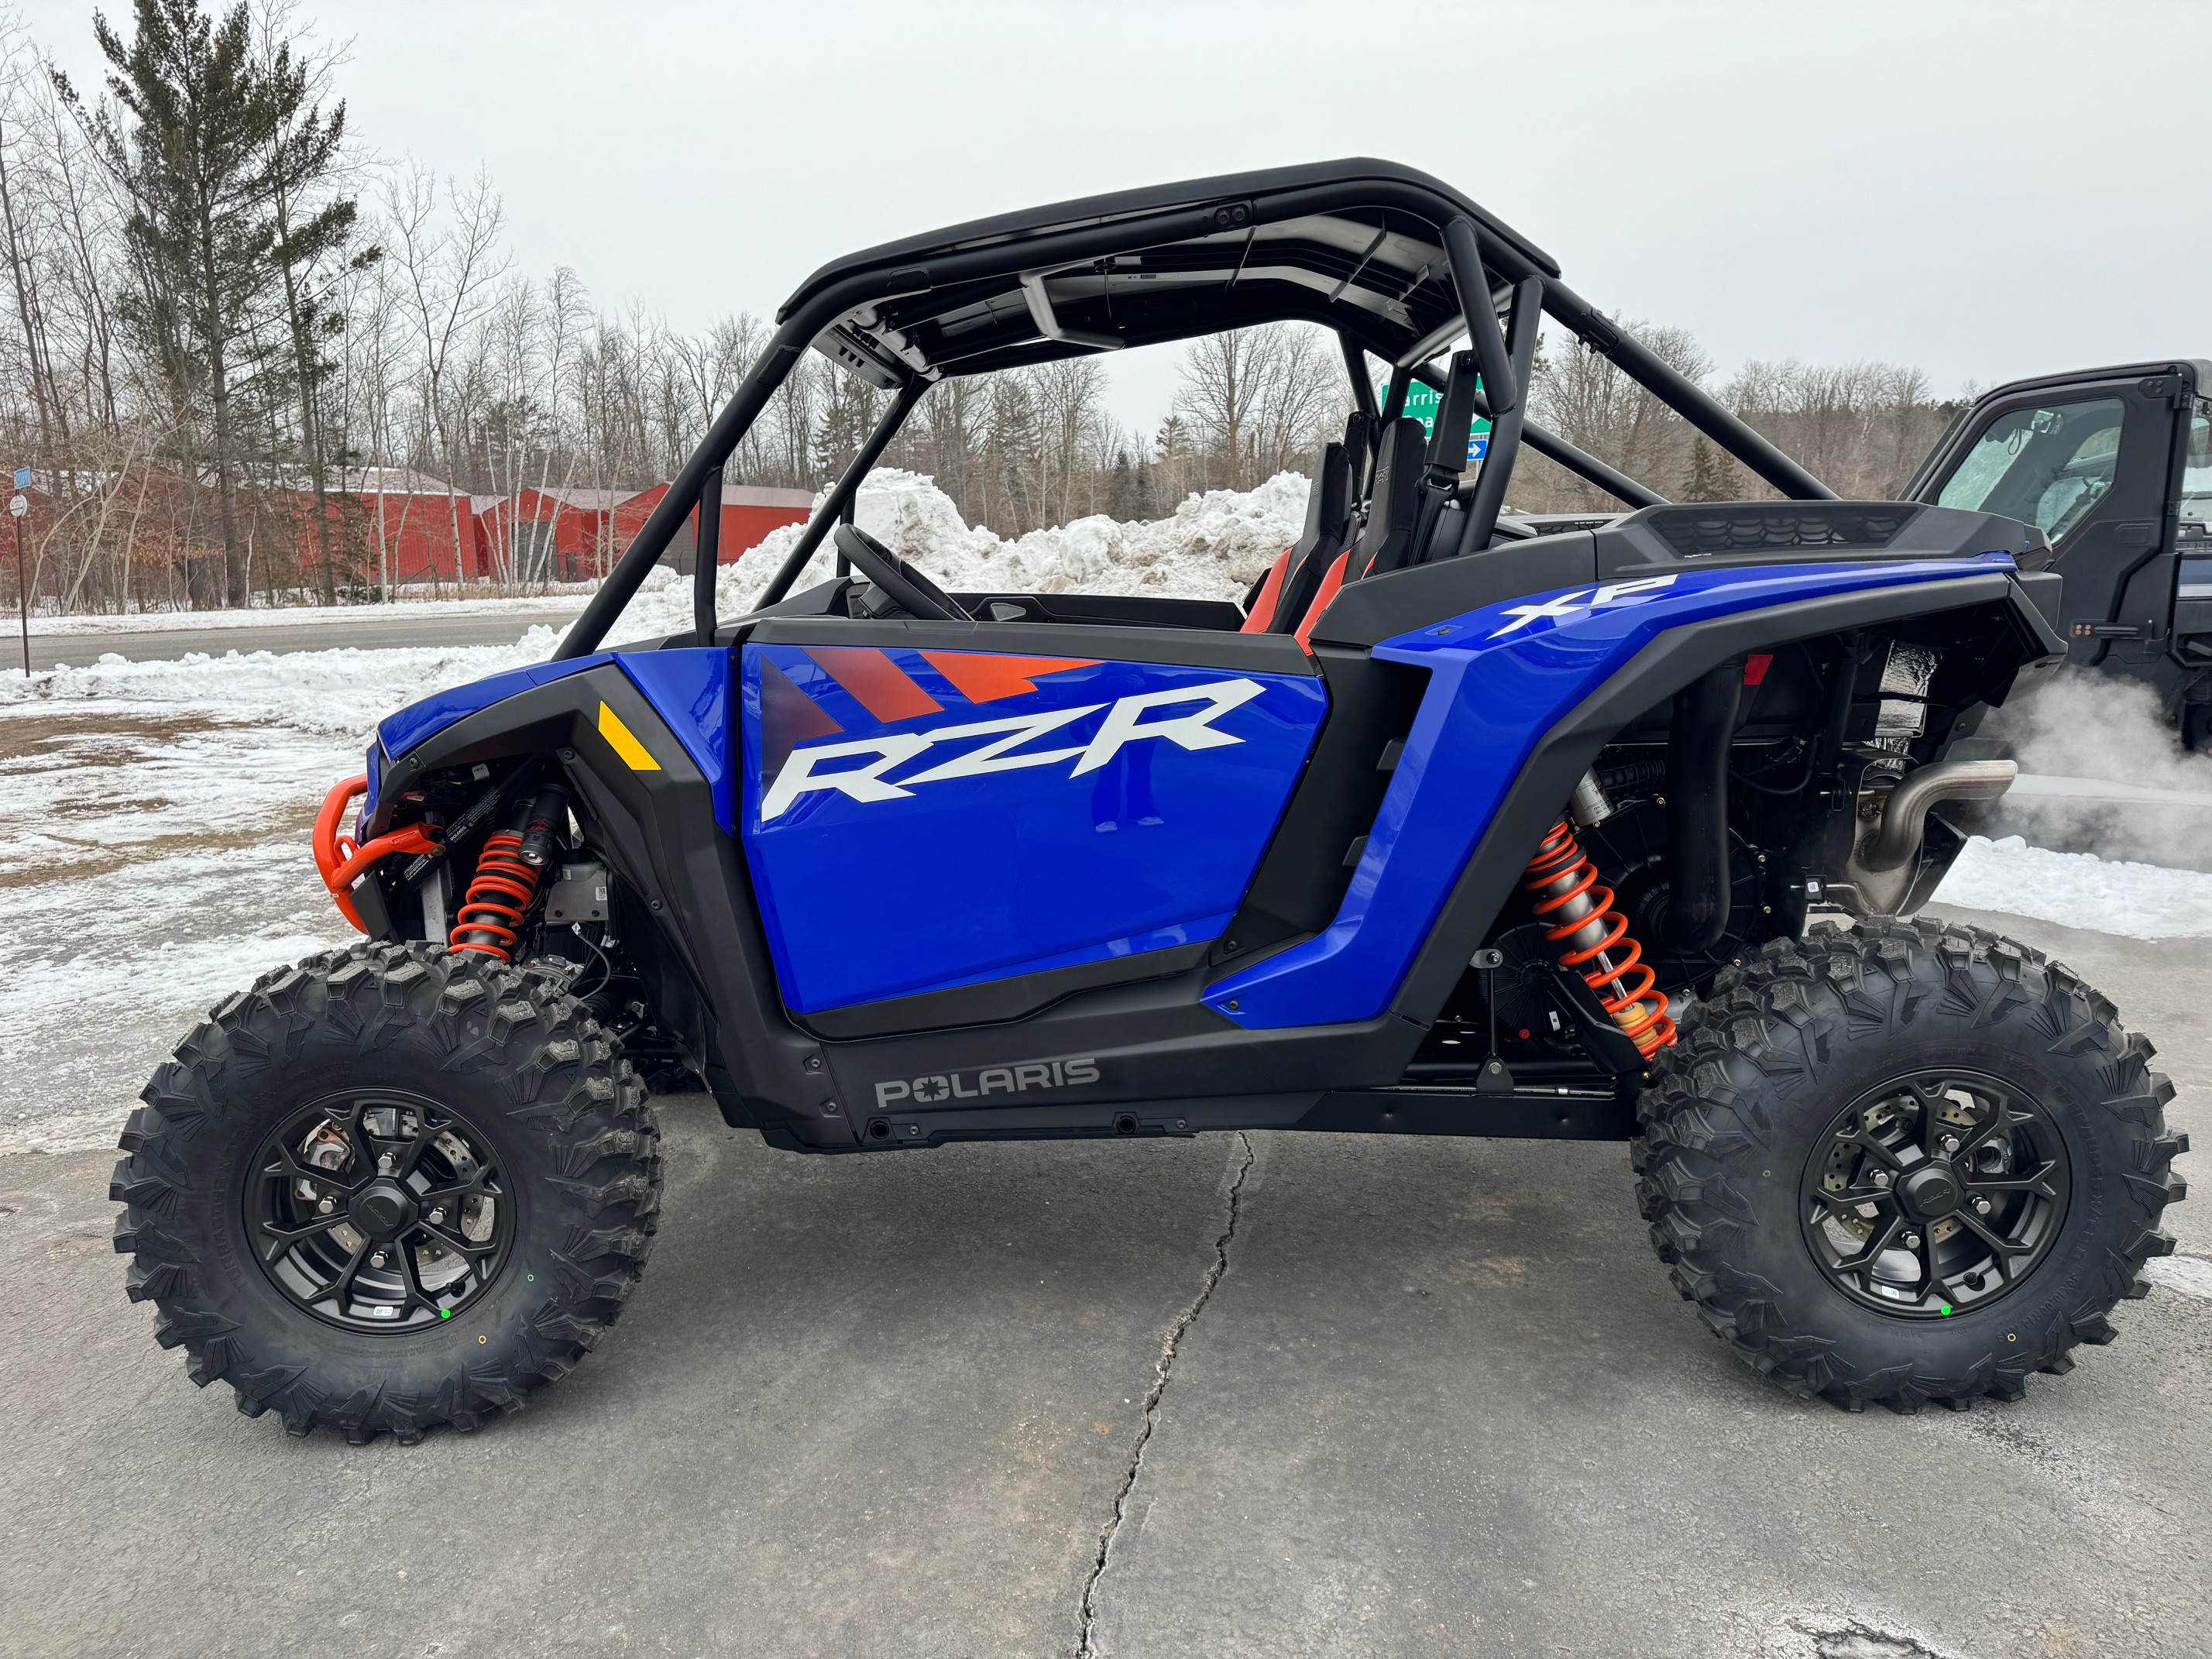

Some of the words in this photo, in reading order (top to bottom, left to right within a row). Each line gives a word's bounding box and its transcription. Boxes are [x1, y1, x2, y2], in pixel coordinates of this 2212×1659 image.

[1485, 573, 1679, 641] XP
[761, 678, 1267, 823] RZR
[874, 1058, 1100, 1108] POLARIS
